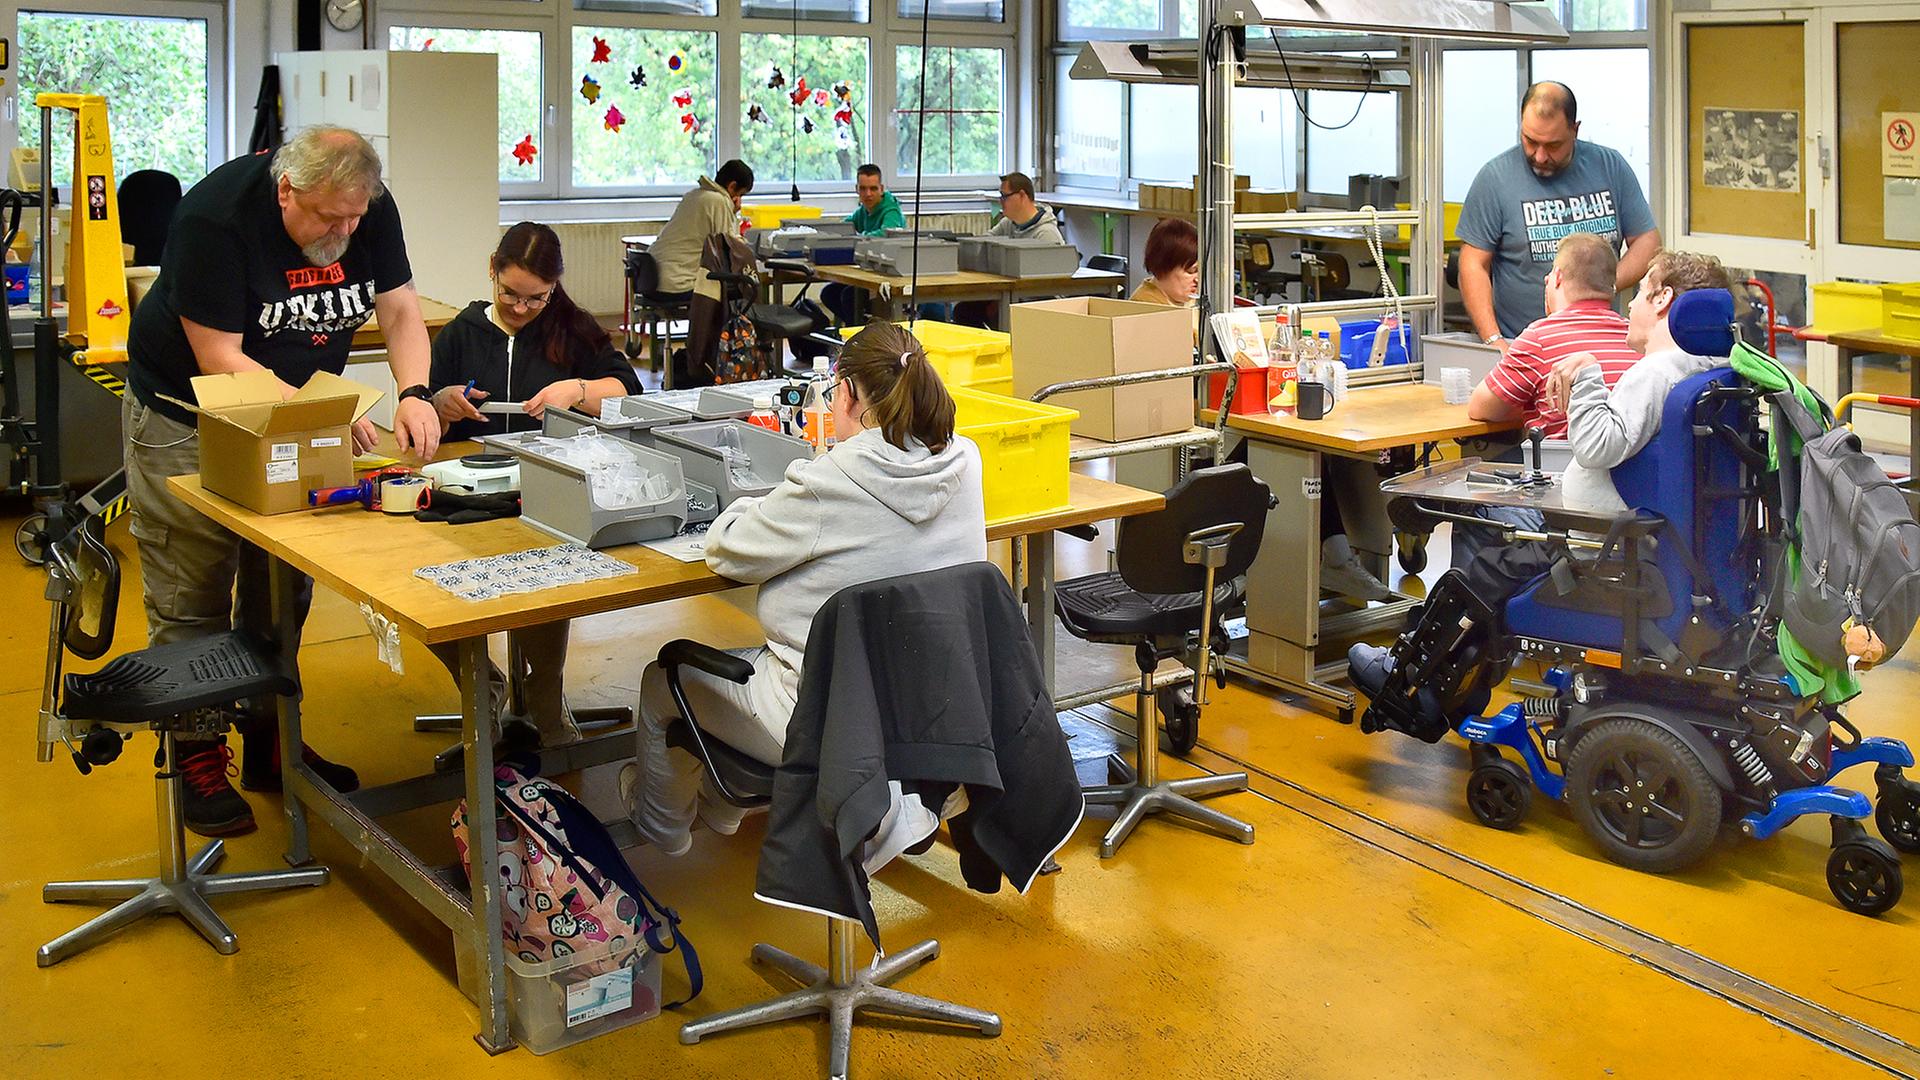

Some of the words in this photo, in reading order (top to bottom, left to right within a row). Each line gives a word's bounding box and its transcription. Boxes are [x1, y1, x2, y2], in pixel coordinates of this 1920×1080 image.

[1522, 201, 1565, 226] DEEP
[1569, 191, 1614, 221] BLUE
[1529, 228, 1551, 240] TRUE
[1553, 225, 1571, 237] BLUE
[1574, 217, 1616, 233] ORIGINALS
[1531, 240, 1557, 253] AUTHE
